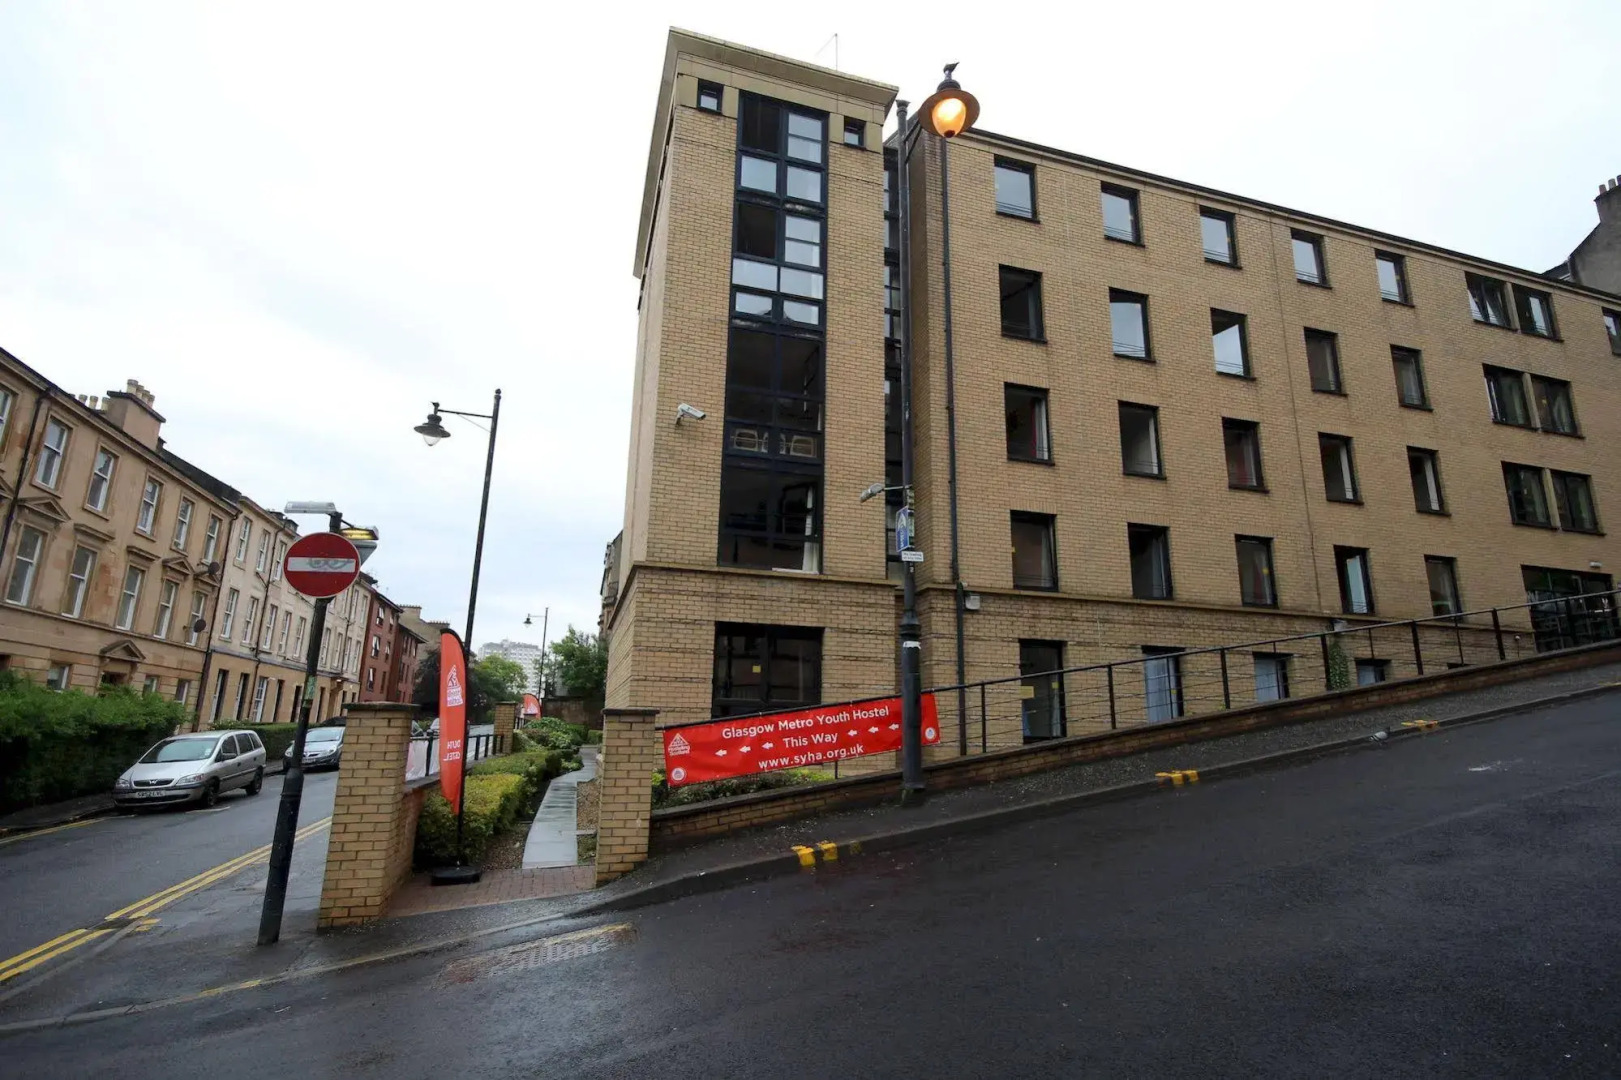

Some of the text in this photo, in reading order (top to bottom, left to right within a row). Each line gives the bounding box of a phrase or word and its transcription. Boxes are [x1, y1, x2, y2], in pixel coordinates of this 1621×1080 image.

[722, 706, 889, 739] Glasgow Metro Youth Hostel
[782, 732, 838, 748] This Way
[758, 744, 864, 769] www.syha.org.uk
